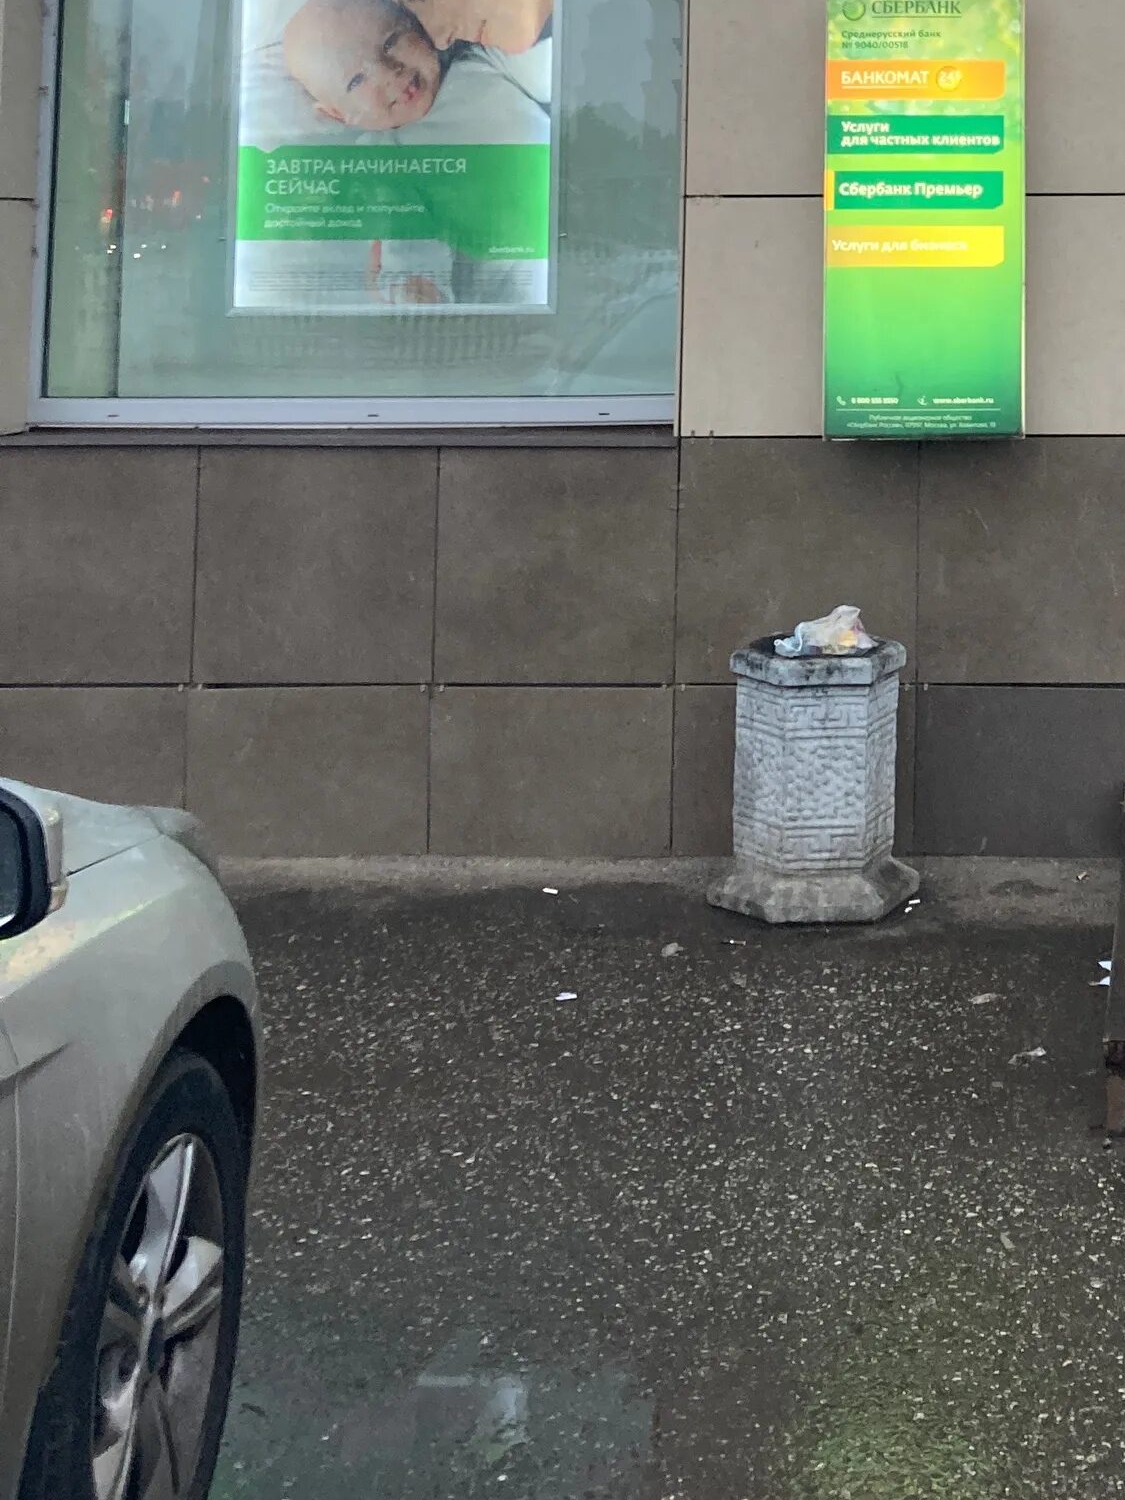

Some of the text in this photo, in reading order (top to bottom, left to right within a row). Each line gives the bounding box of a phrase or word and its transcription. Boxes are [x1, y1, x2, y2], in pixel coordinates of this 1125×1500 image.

[872, 0, 961, 14] СБЕРБАНК
[841, 29, 941, 39] Среднерусский банк
[841, 70, 929, 85] БАНКОМАТ
[841, 121, 890, 136] Услуги
[841, 134, 1000, 147] для частных клиентов
[266, 158, 467, 175] ЗАВТРА НАЧИНАЕТСЯ
[265, 177, 341, 195] СЕЙЧАС
[839, 182, 983, 199] Сбербанк Премьер
[832, 239, 880, 254] Услуги
[881, 240, 907, 252] для
